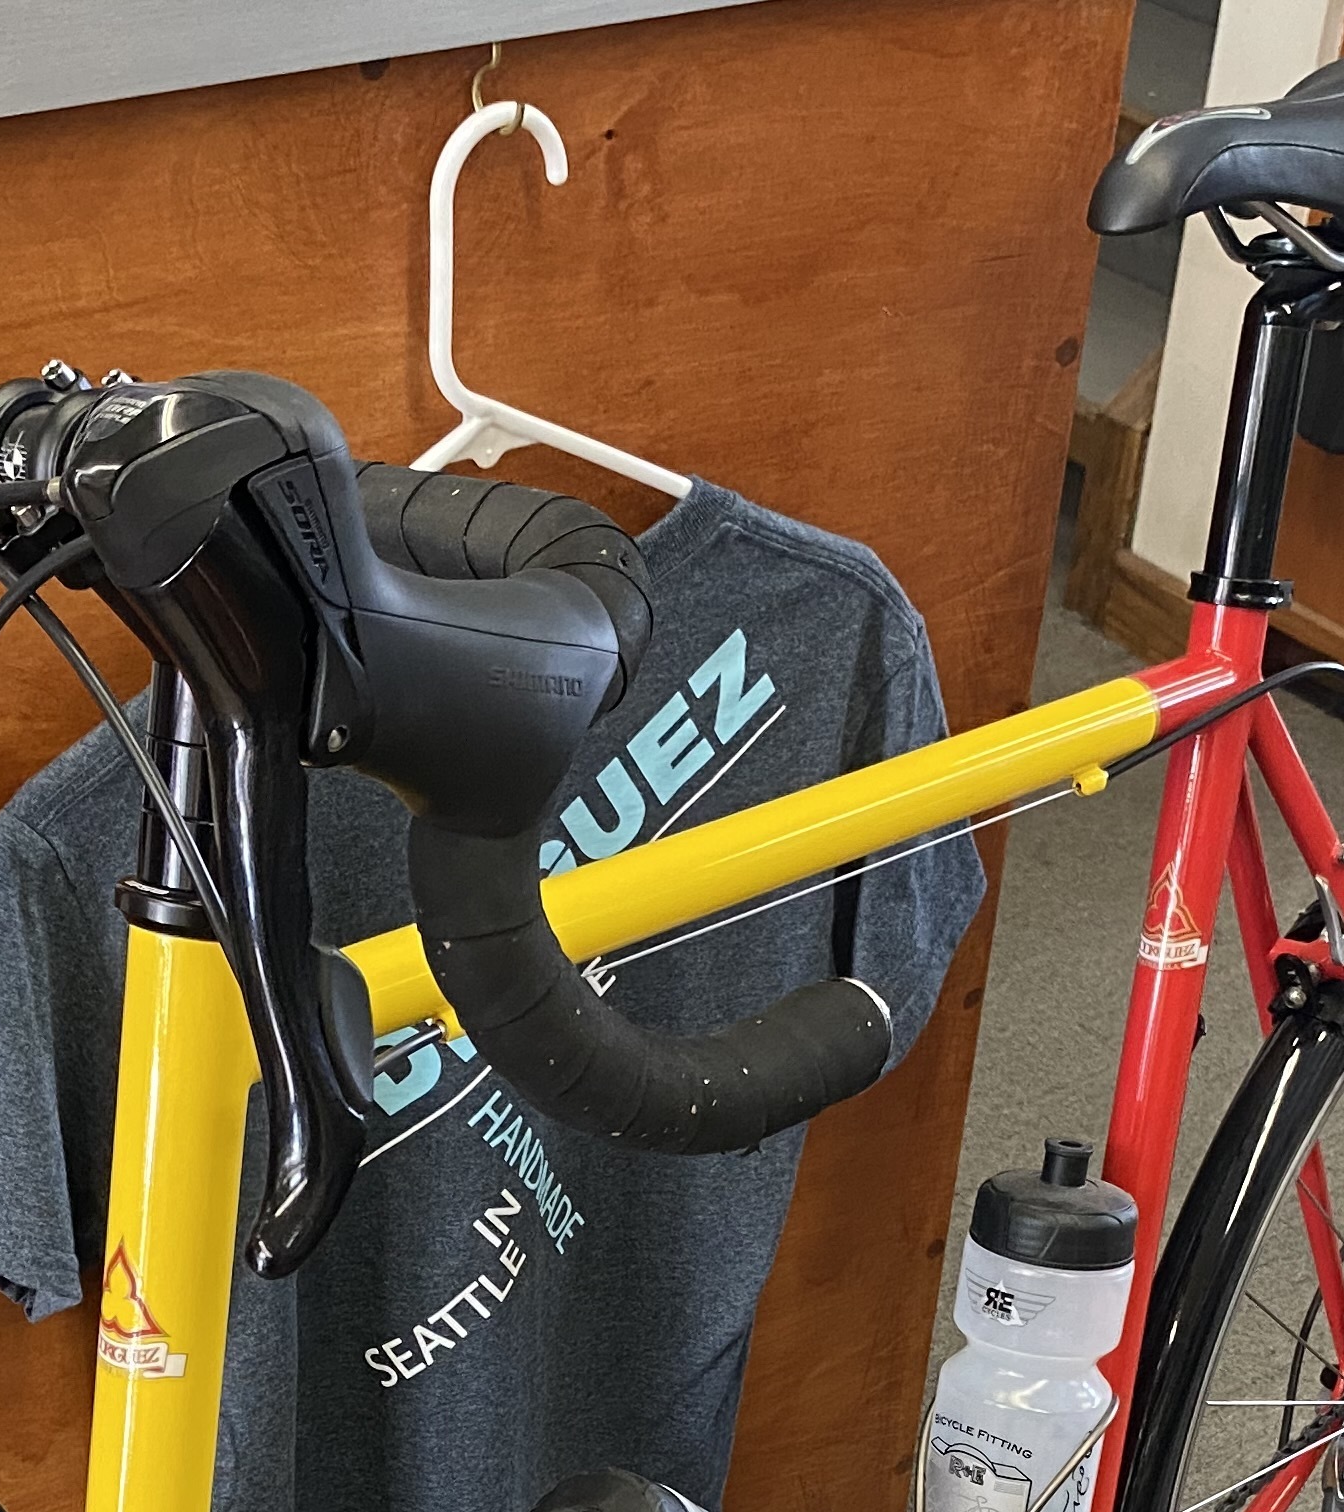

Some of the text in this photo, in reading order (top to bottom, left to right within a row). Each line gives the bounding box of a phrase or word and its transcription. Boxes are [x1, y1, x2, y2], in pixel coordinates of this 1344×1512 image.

[489, 667, 583, 698] SHIMANO
[468, 1090, 585, 1255] HANDMADE
[472, 1187, 522, 1248] IN
[364, 1246, 527, 1388] SEATTLE
[935, 1413, 1033, 1460] BICYCLE FITTING
